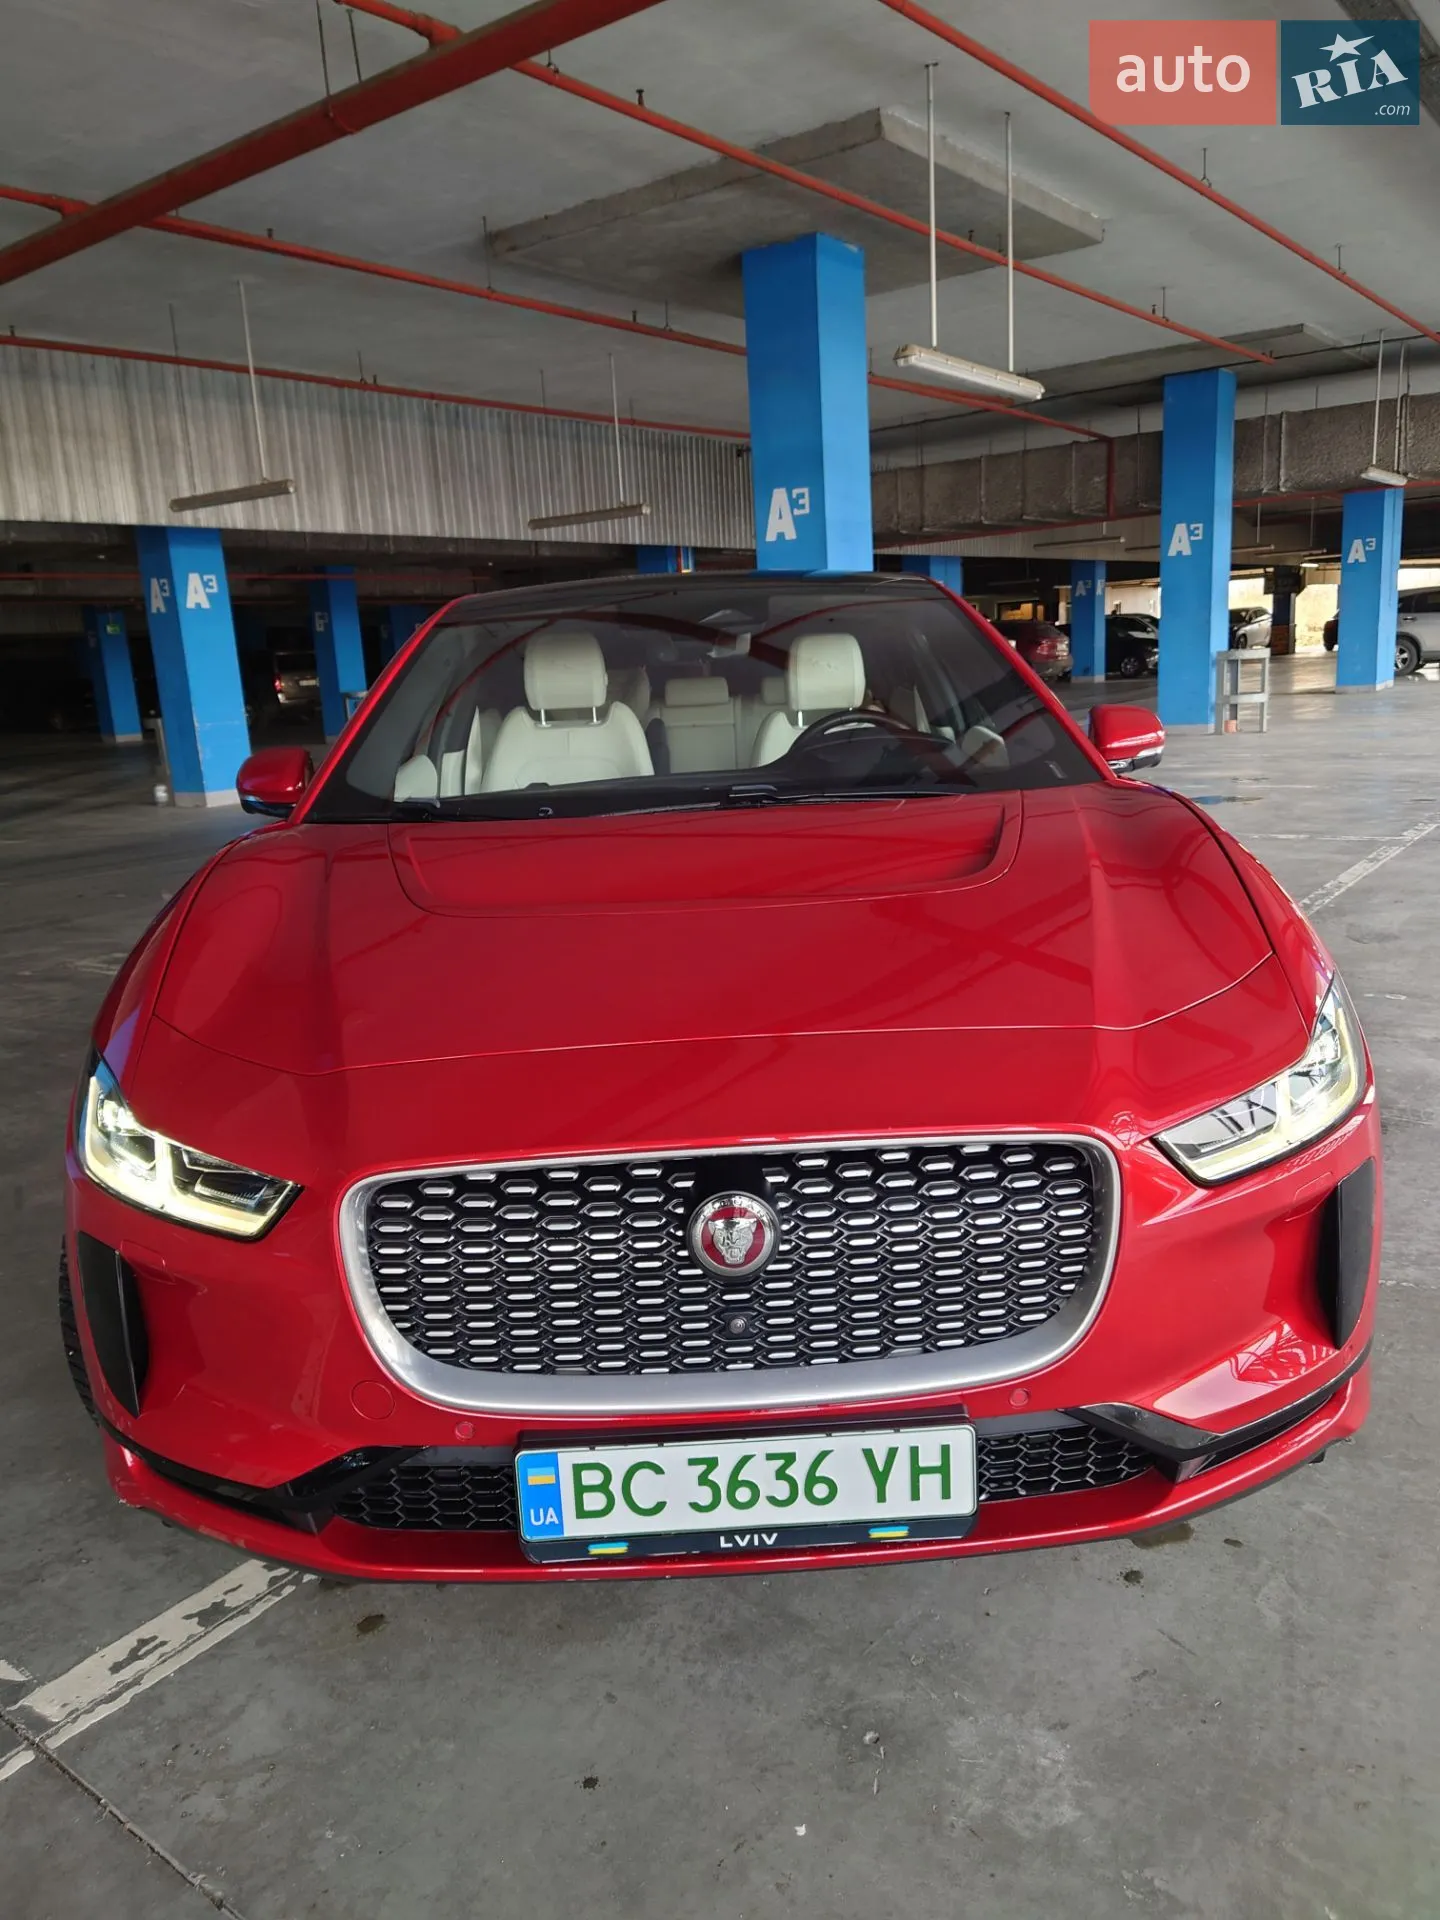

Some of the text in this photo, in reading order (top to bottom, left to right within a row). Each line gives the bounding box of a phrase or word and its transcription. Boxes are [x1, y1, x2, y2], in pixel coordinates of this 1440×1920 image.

[571, 1443, 951, 1520] BC 3636 YH
[529, 1506, 560, 1526] UA
[719, 1532, 778, 1549] LVIV
